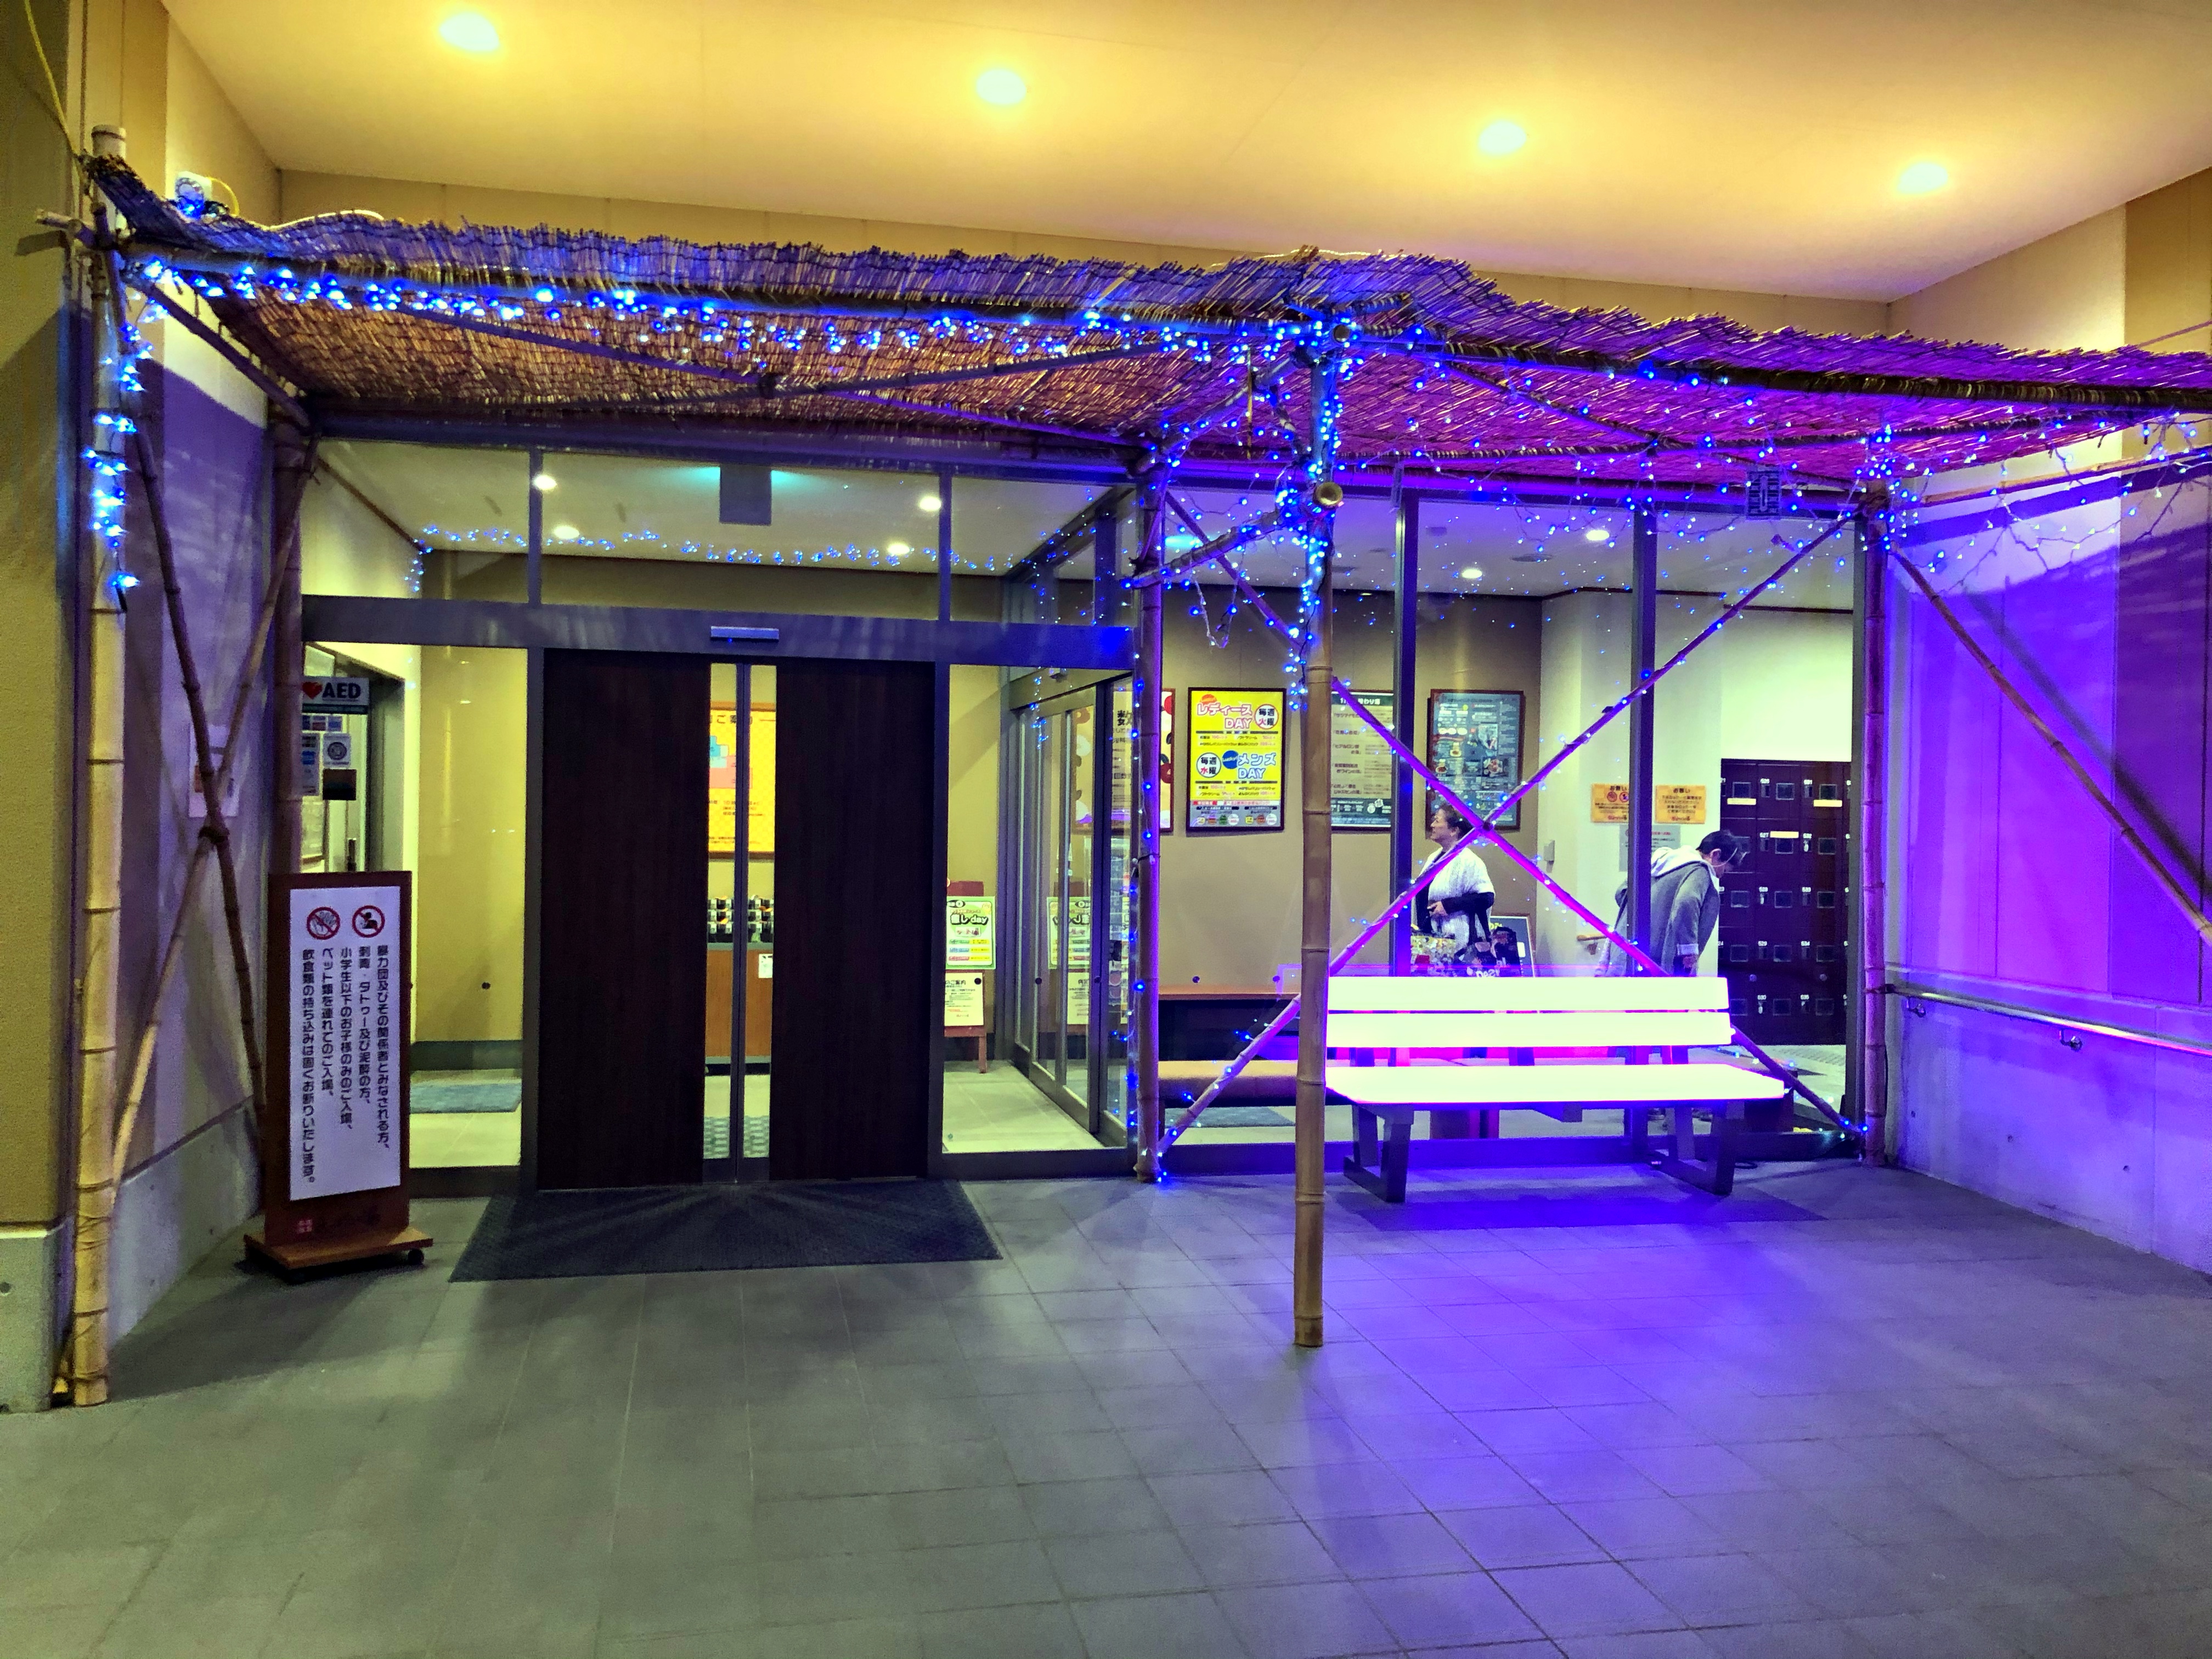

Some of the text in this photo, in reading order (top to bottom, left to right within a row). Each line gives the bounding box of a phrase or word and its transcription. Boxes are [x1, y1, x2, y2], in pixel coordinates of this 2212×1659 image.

[322, 682, 361, 698] AED
[1197, 702, 1253, 716] レディース
[1259, 708, 1275, 716] 毎週
[1224, 718, 1253, 729] DAY
[1258, 718, 1275, 726] 火曜
[1200, 757, 1217, 765] 毎週
[1238, 752, 1277, 766] メンズ
[1200, 766, 1217, 775] 水曜
[1238, 768, 1266, 779] DAY
